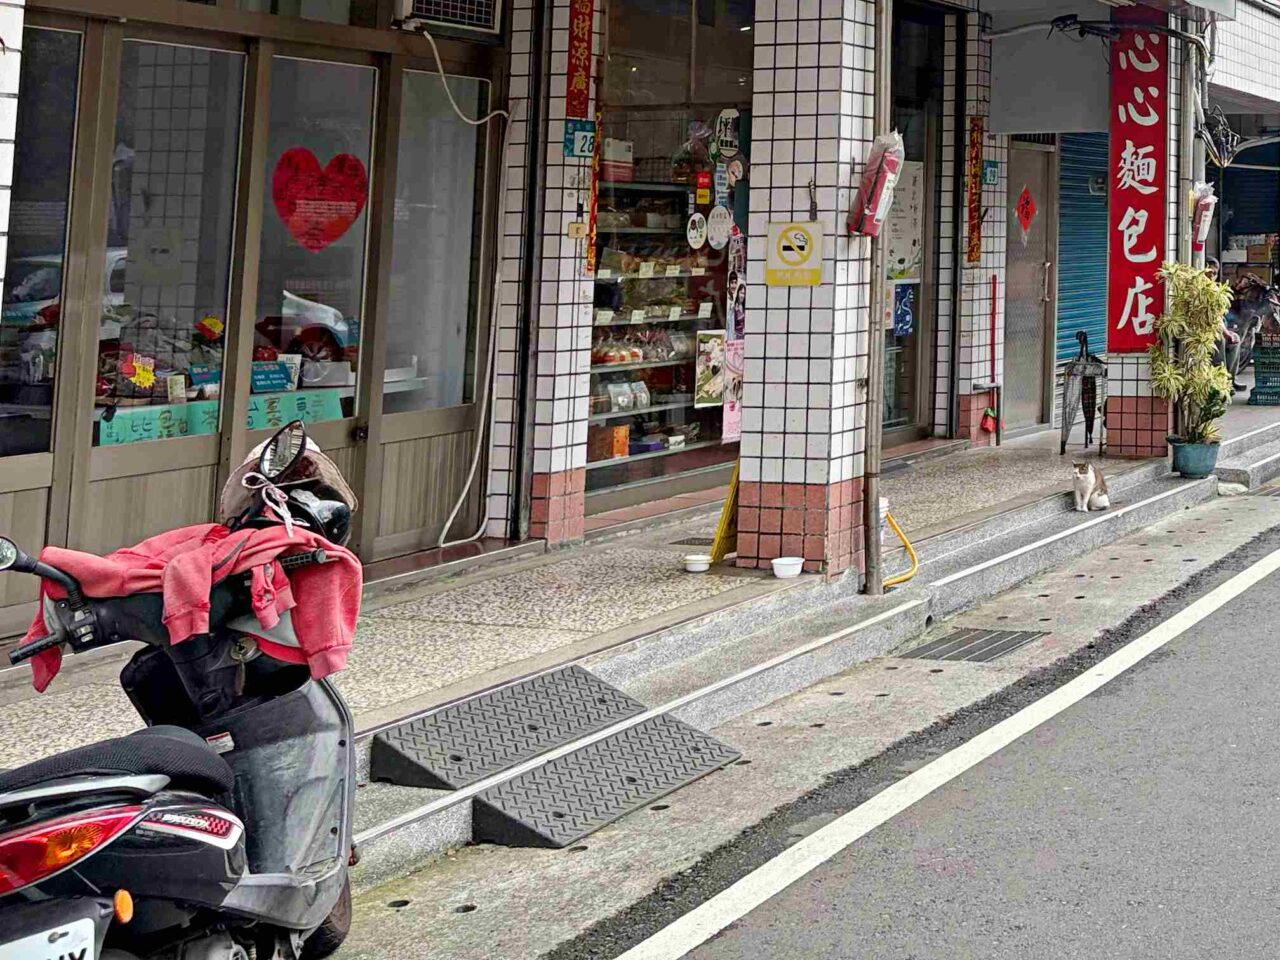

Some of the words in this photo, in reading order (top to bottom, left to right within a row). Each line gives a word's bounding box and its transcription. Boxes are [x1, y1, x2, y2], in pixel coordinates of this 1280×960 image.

[579, 134, 596, 154] 28
[1116, 33, 1161, 337] 心心麵包店
